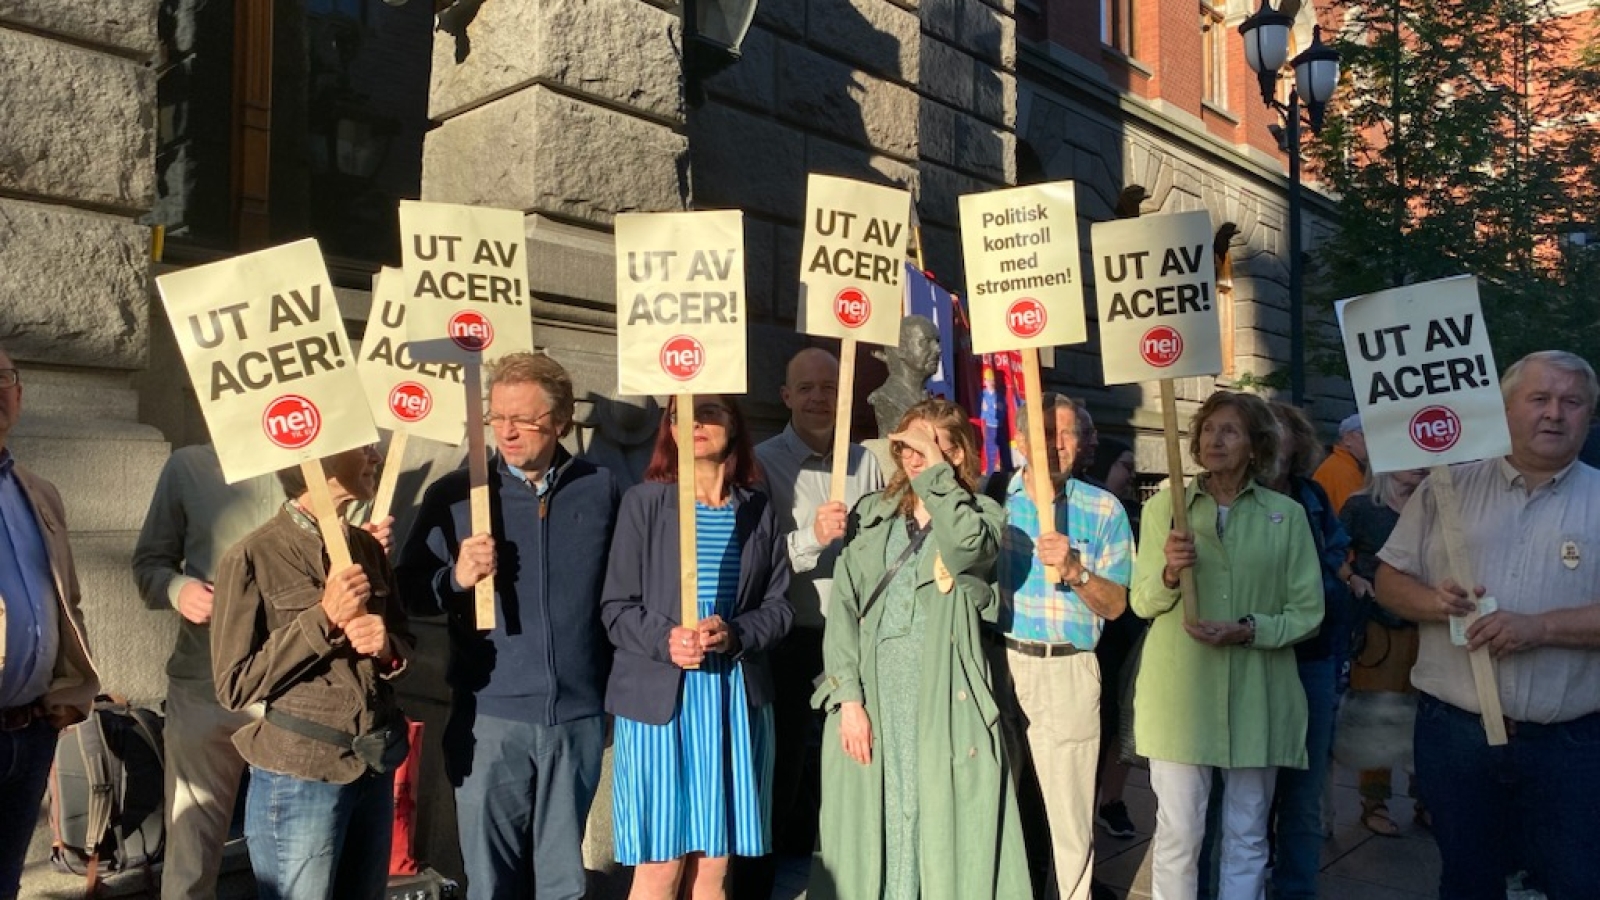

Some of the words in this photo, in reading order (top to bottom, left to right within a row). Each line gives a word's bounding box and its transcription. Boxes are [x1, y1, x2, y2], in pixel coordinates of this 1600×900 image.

[815, 208, 857, 239] UT
[863, 218, 902, 247] AV
[983, 204, 1048, 228] Politisk
[414, 234, 462, 262] UT
[472, 238, 518, 268] AV
[983, 227, 1050, 252] kontroll
[627, 251, 677, 282] UT
[686, 249, 736, 281] AV
[809, 244, 899, 286] ACER!
[1000, 252, 1038, 272] med
[1104, 251, 1149, 283] UT
[1160, 244, 1203, 277] AV
[413, 270, 522, 306] ACER!
[976, 267, 1072, 295] strømmen!
[189, 302, 249, 349] UT
[269, 285, 321, 333] AV
[381, 300, 405, 328] U
[627, 292, 738, 325] ACER!
[838, 297, 867, 316] nei
[1010, 302, 1042, 326] nei
[1107, 282, 1211, 322] ACER!
[453, 318, 488, 338] nei
[1144, 331, 1176, 354] nei
[1358, 325, 1411, 362] UT
[1425, 314, 1474, 352] AV
[209, 331, 345, 401] ACER!
[665, 342, 700, 366] nei
[1368, 354, 1490, 405] ACER!
[393, 391, 429, 411] nei
[268, 401, 313, 435] nei
[1415, 410, 1455, 440] nei
